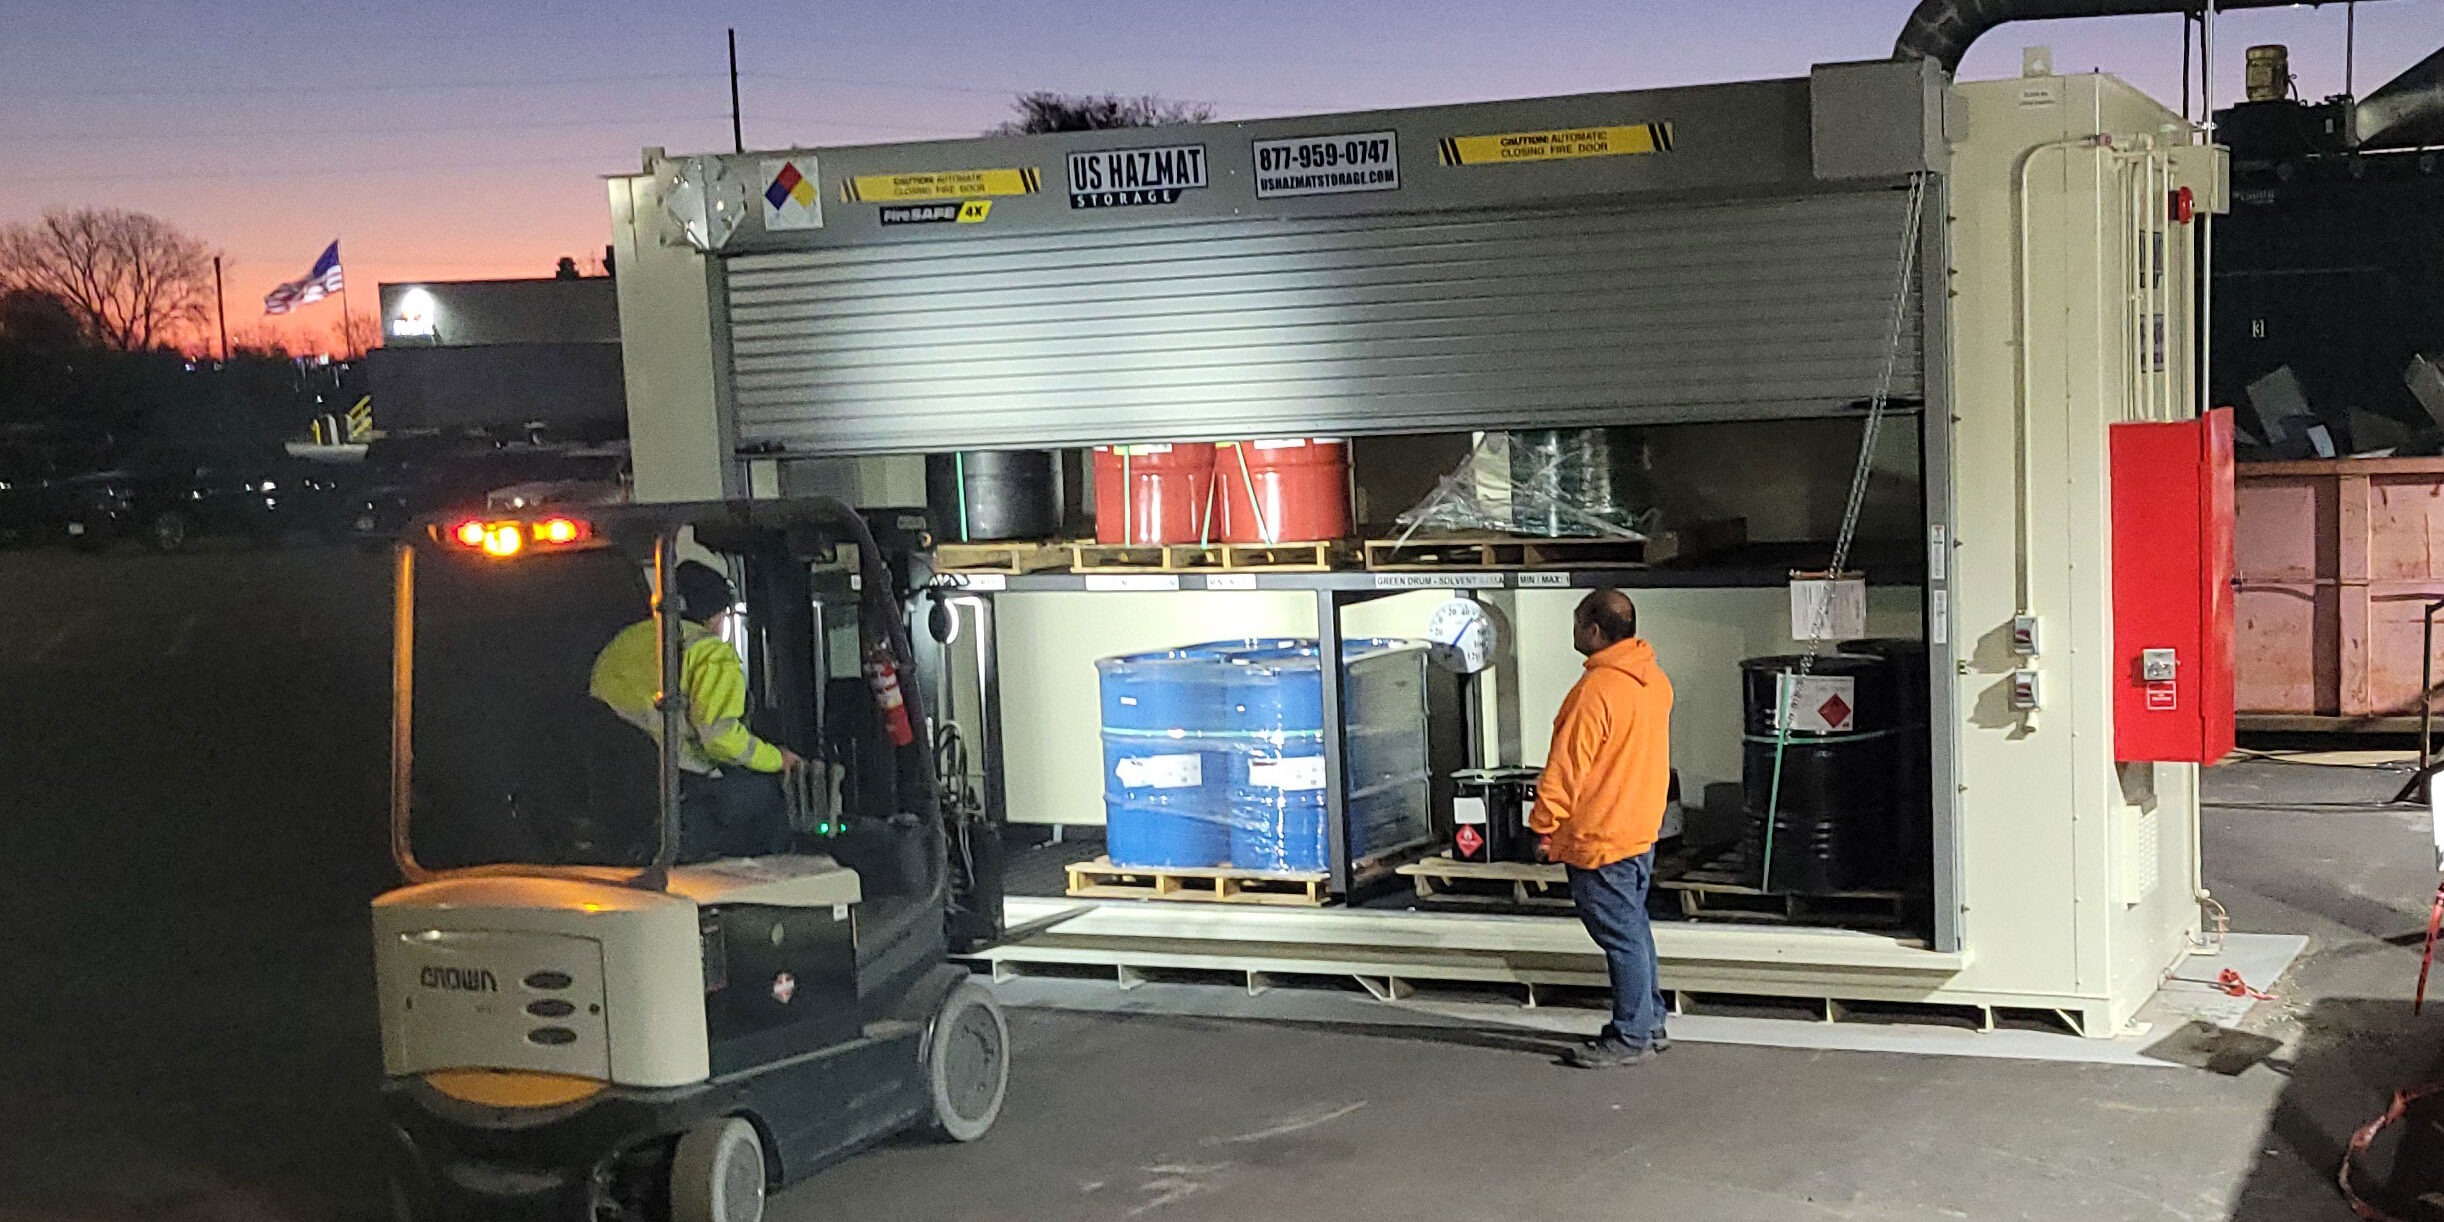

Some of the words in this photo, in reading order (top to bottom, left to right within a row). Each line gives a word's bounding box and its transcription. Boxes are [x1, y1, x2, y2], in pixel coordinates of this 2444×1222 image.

[1551, 130, 1607, 143] AUTOMATIC
[1260, 139, 1389, 171] 877-959-0747
[1501, 146, 1545, 158] CLOSING
[1550, 144, 1573, 154] FIRE
[1578, 141, 1608, 152] DOOR
[1073, 155, 1102, 190] US
[1108, 148, 1200, 188] HAZMAT
[1260, 169, 1394, 191] USHAZMATSTORAGE.COM
[1077, 189, 1171, 208] STORAGE
[965, 206, 983, 217] 4X
[1377, 576, 1406, 586] GREEN
[1407, 575, 1432, 586] DRUM
[1439, 575, 1476, 585] SOLVENT
[1520, 575, 1535, 584] MIN
